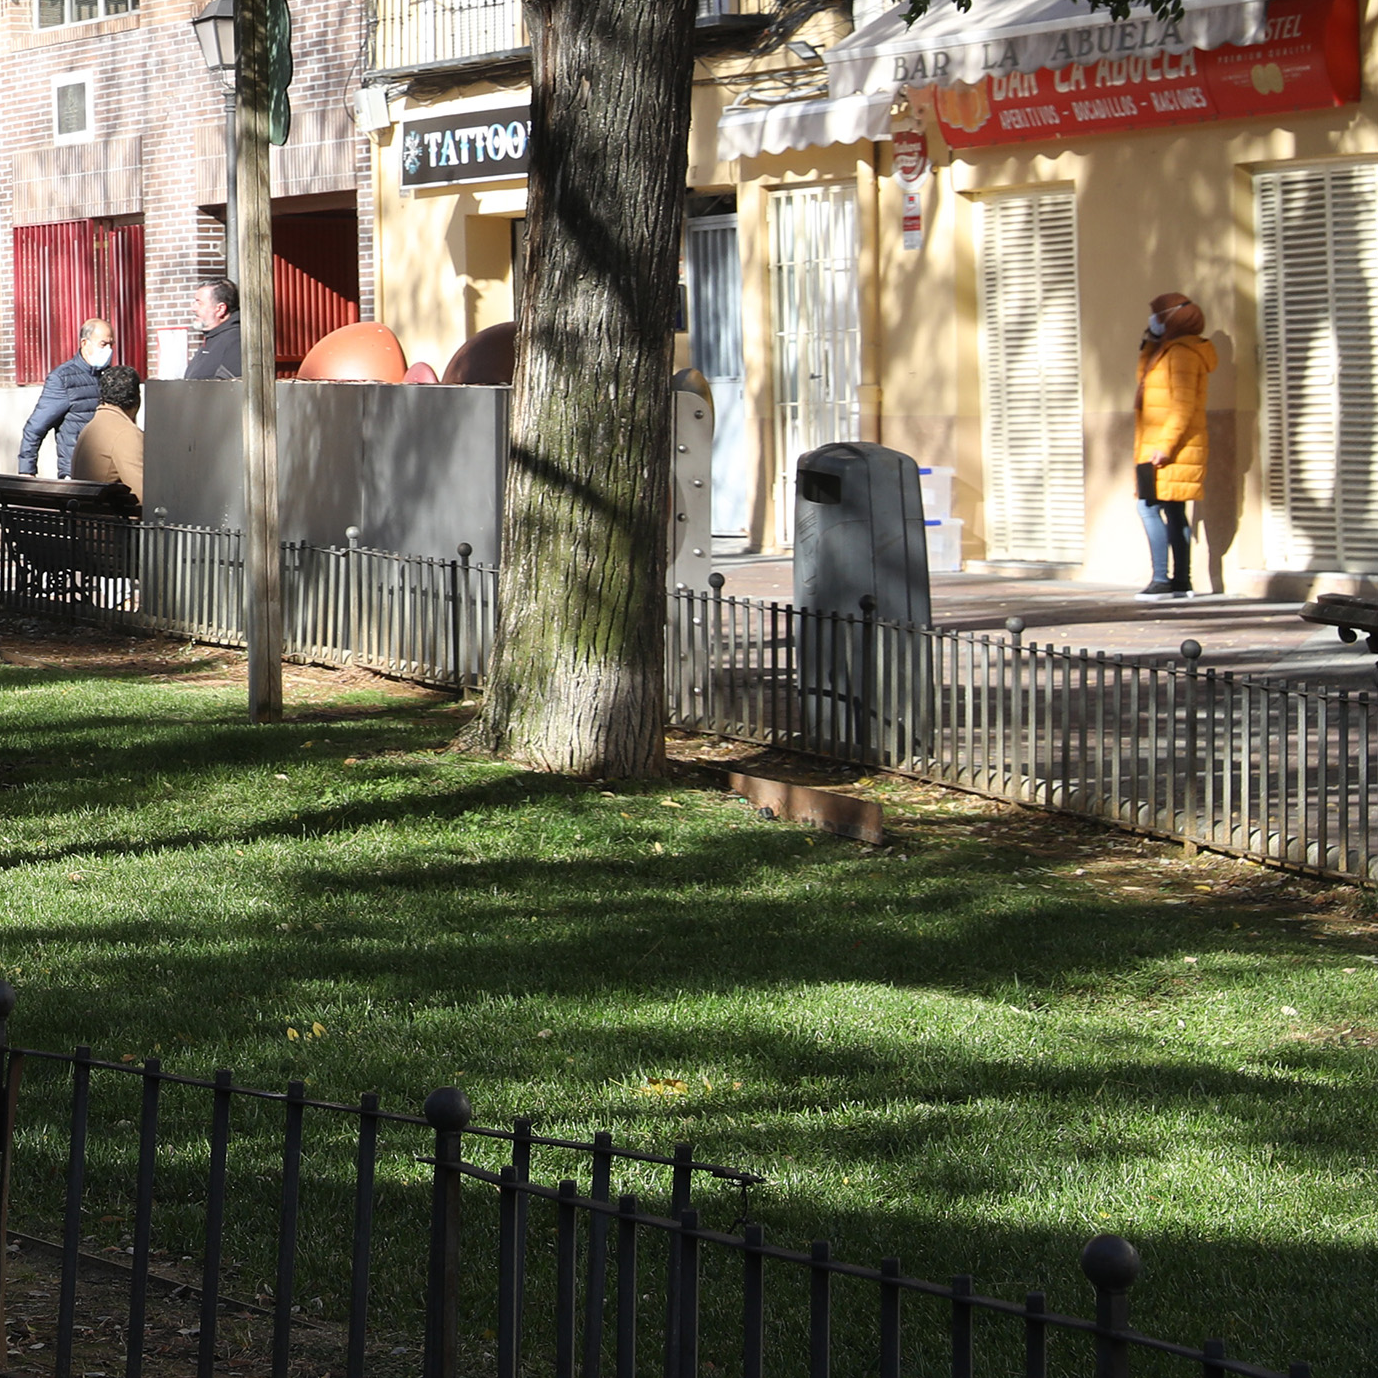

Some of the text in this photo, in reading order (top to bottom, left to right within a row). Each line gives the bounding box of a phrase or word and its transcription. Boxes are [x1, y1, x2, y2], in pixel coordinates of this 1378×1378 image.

[1264, 14, 1302, 41] STEL
[893, 20, 1183, 82] BAR LA ABUELA
[999, 105, 1060, 129] APERITIVOS
[1071, 95, 1137, 121] BOCADILLOS
[1150, 86, 1207, 113] RACIONES
[424, 121, 531, 168] TATTOO
